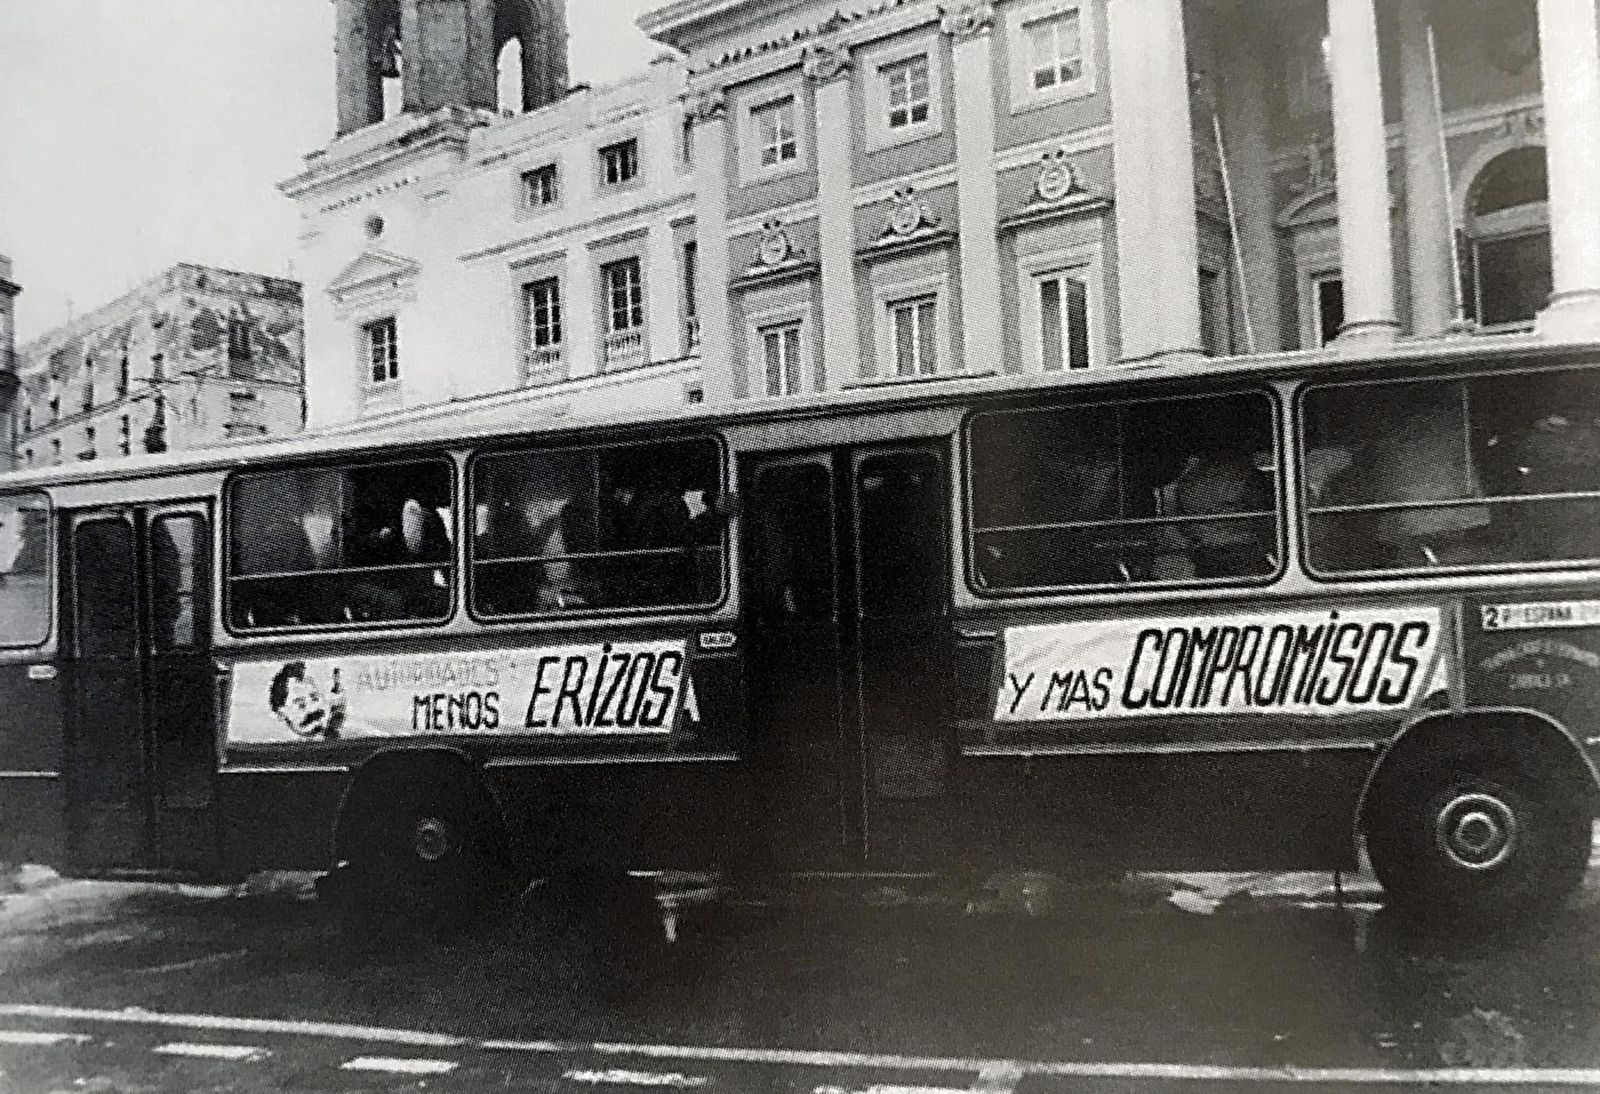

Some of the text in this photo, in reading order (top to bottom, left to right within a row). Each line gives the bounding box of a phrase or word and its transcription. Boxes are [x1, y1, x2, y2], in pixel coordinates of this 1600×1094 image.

[412, 643, 682, 731] MENOS ERIZOS
[1008, 671, 1035, 714] Y
[1040, 667, 1113, 711] MAS
[1121, 610, 1431, 709] COMPROMISOS
